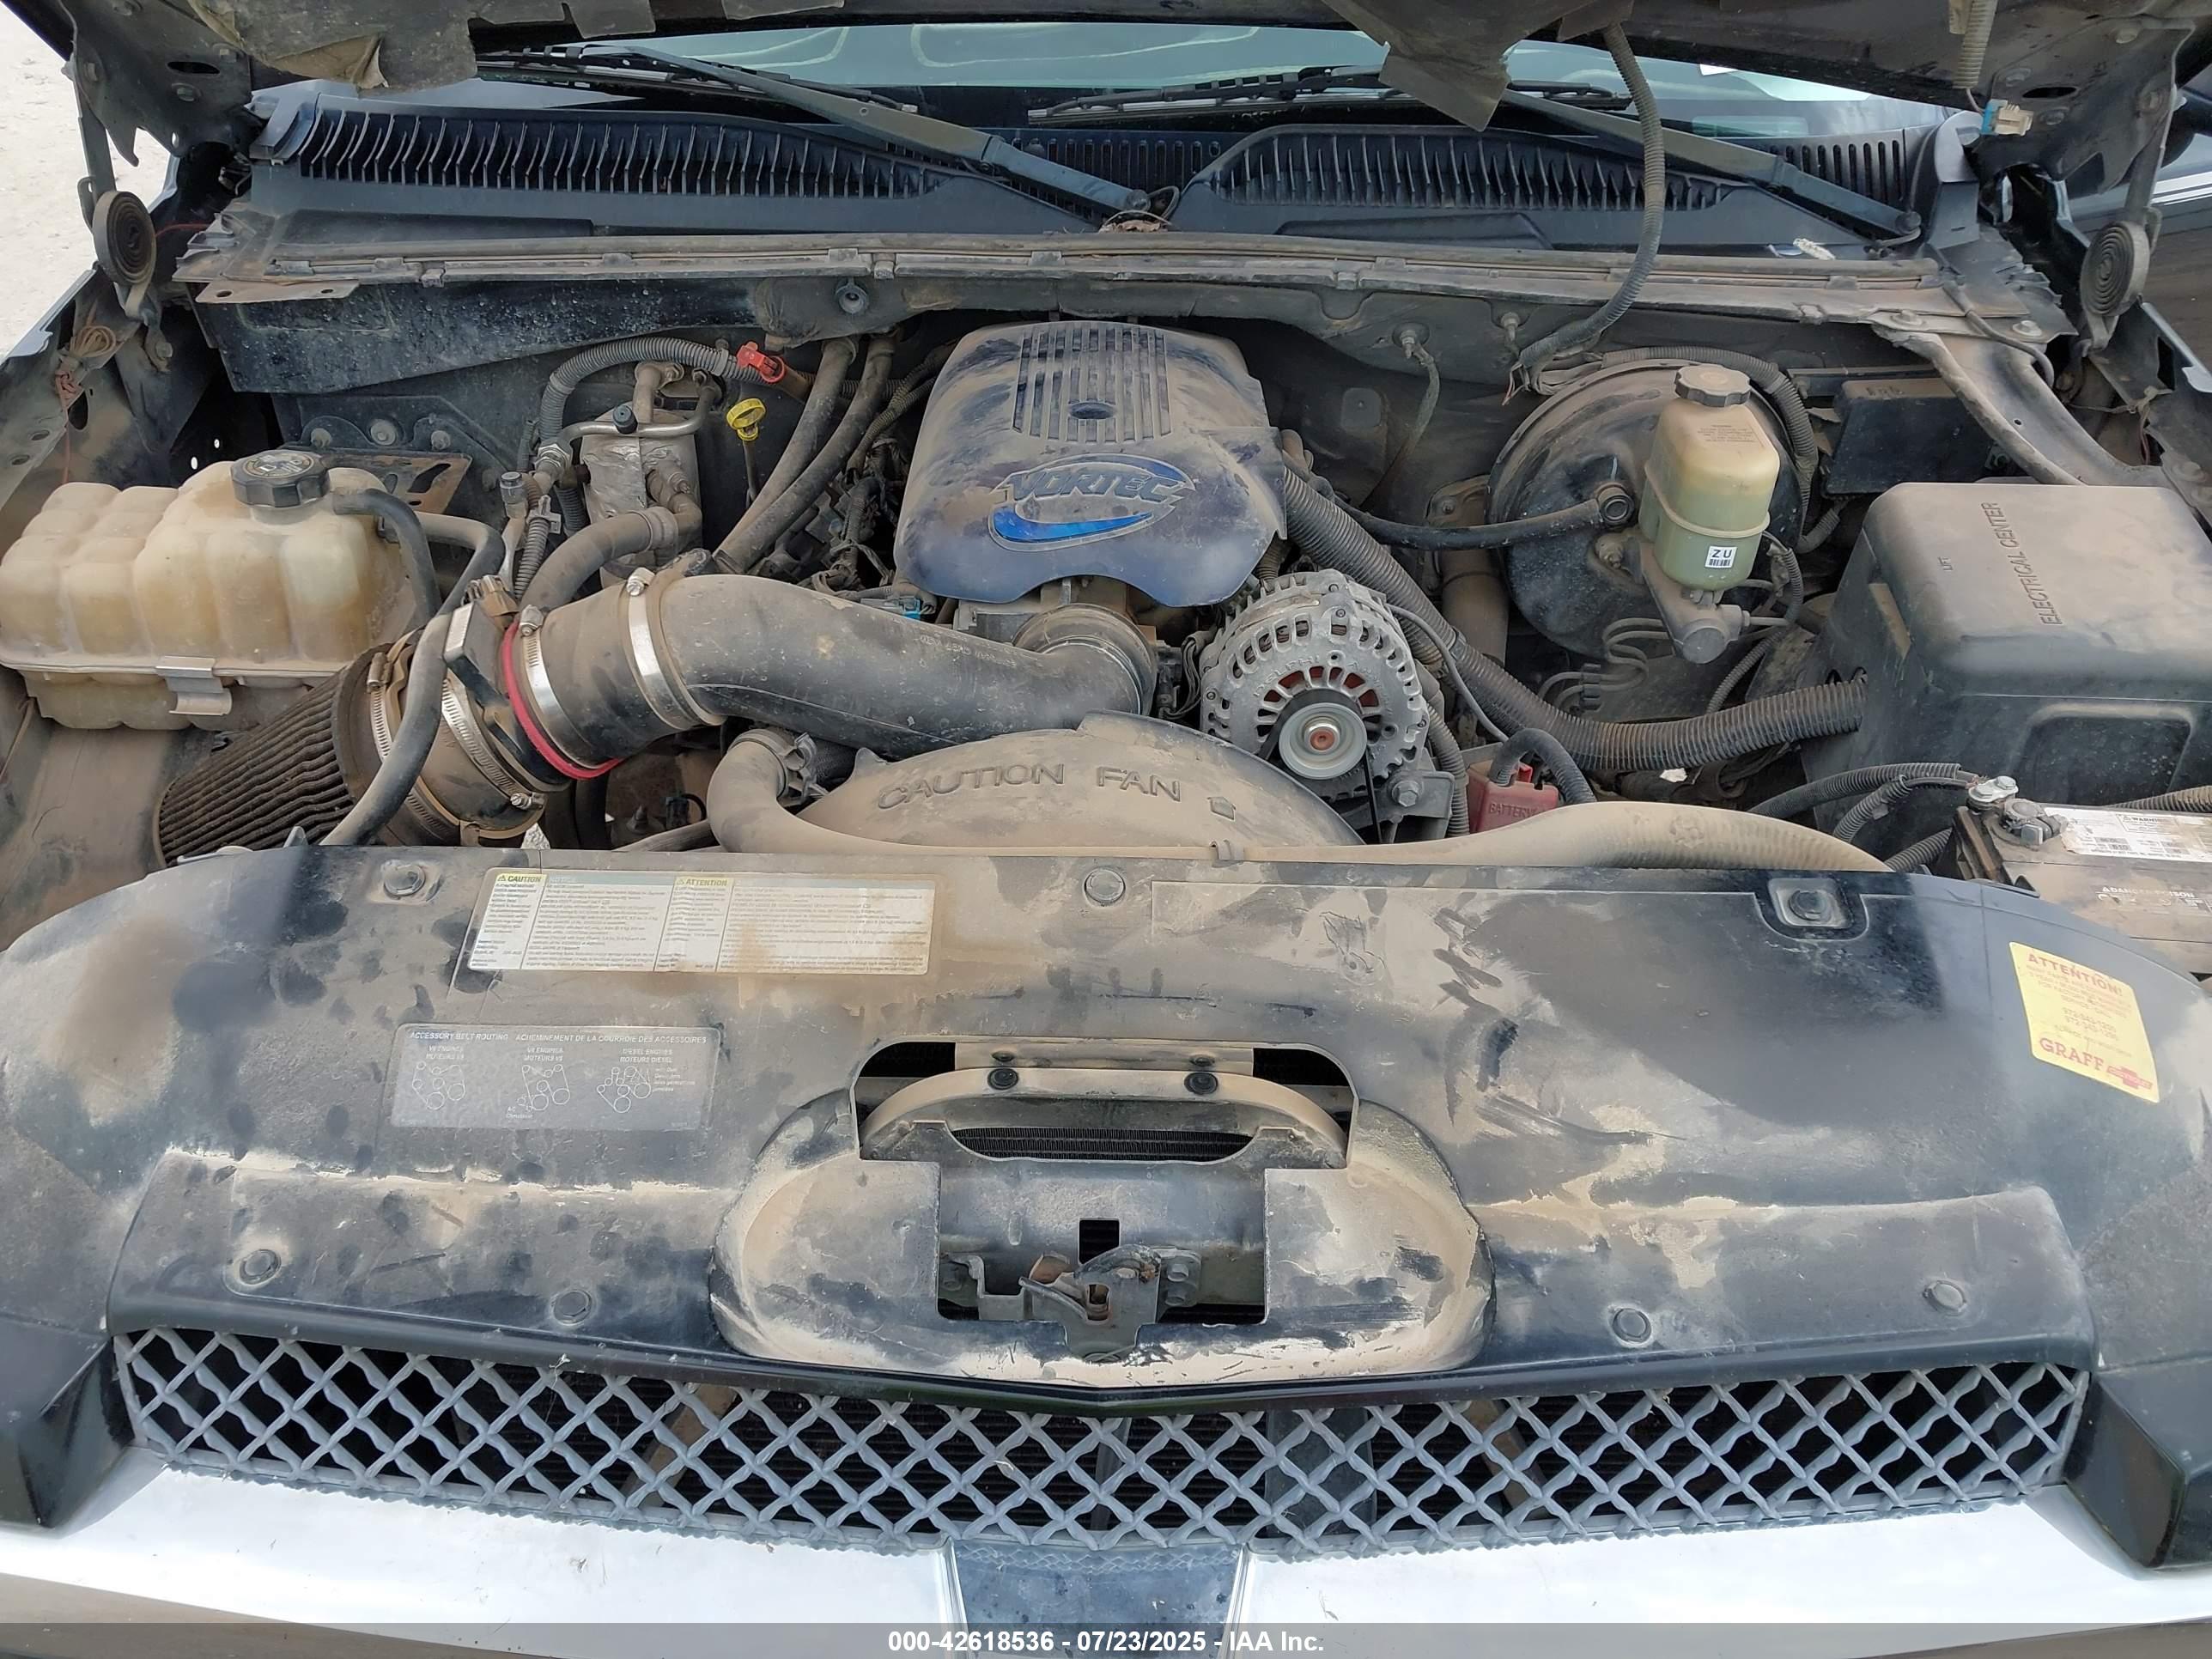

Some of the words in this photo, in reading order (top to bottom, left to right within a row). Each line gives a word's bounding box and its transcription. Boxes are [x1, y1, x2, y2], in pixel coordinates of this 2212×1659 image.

[996, 467, 1184, 504] VORTEC
[1980, 501, 2021, 550] CENTER
[2005, 550, 2063, 625] ELECTRICAL
[1253, 654, 1320, 697] DELPHI
[878, 762, 1065, 810] CAUTION
[1097, 766, 1182, 802] FAN
[507, 874, 542, 884] CAUTION
[685, 878, 729, 888] ATTENTION
[410, 1031, 454, 1040] ACCESSORY
[515, 1033, 574, 1042] ACHEMINEMENT
[2039, 1036, 2104, 1072] GRAFF
